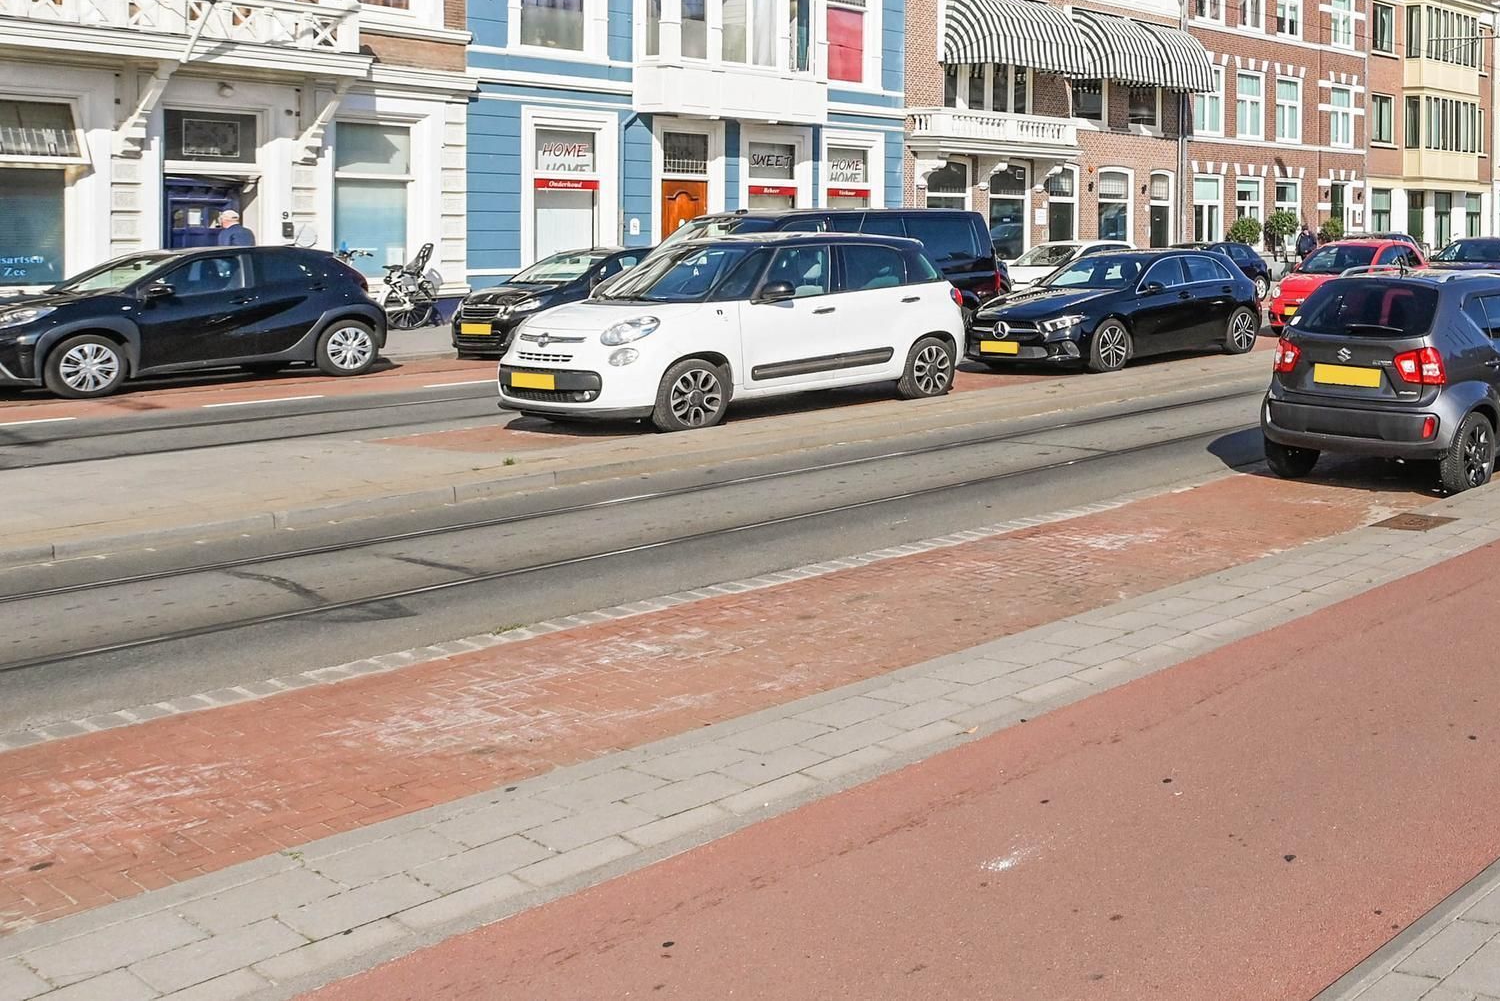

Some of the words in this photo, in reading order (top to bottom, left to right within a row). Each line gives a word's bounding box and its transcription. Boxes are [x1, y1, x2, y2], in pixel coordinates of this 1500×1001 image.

[542, 143, 588, 157] HOME
[751, 153, 792, 167] SWEET
[831, 159, 862, 170] HOME
[548, 180, 583, 188] Onderhoud
[282, 211, 289, 220] 9
[0, 255, 44, 264] sartsen
